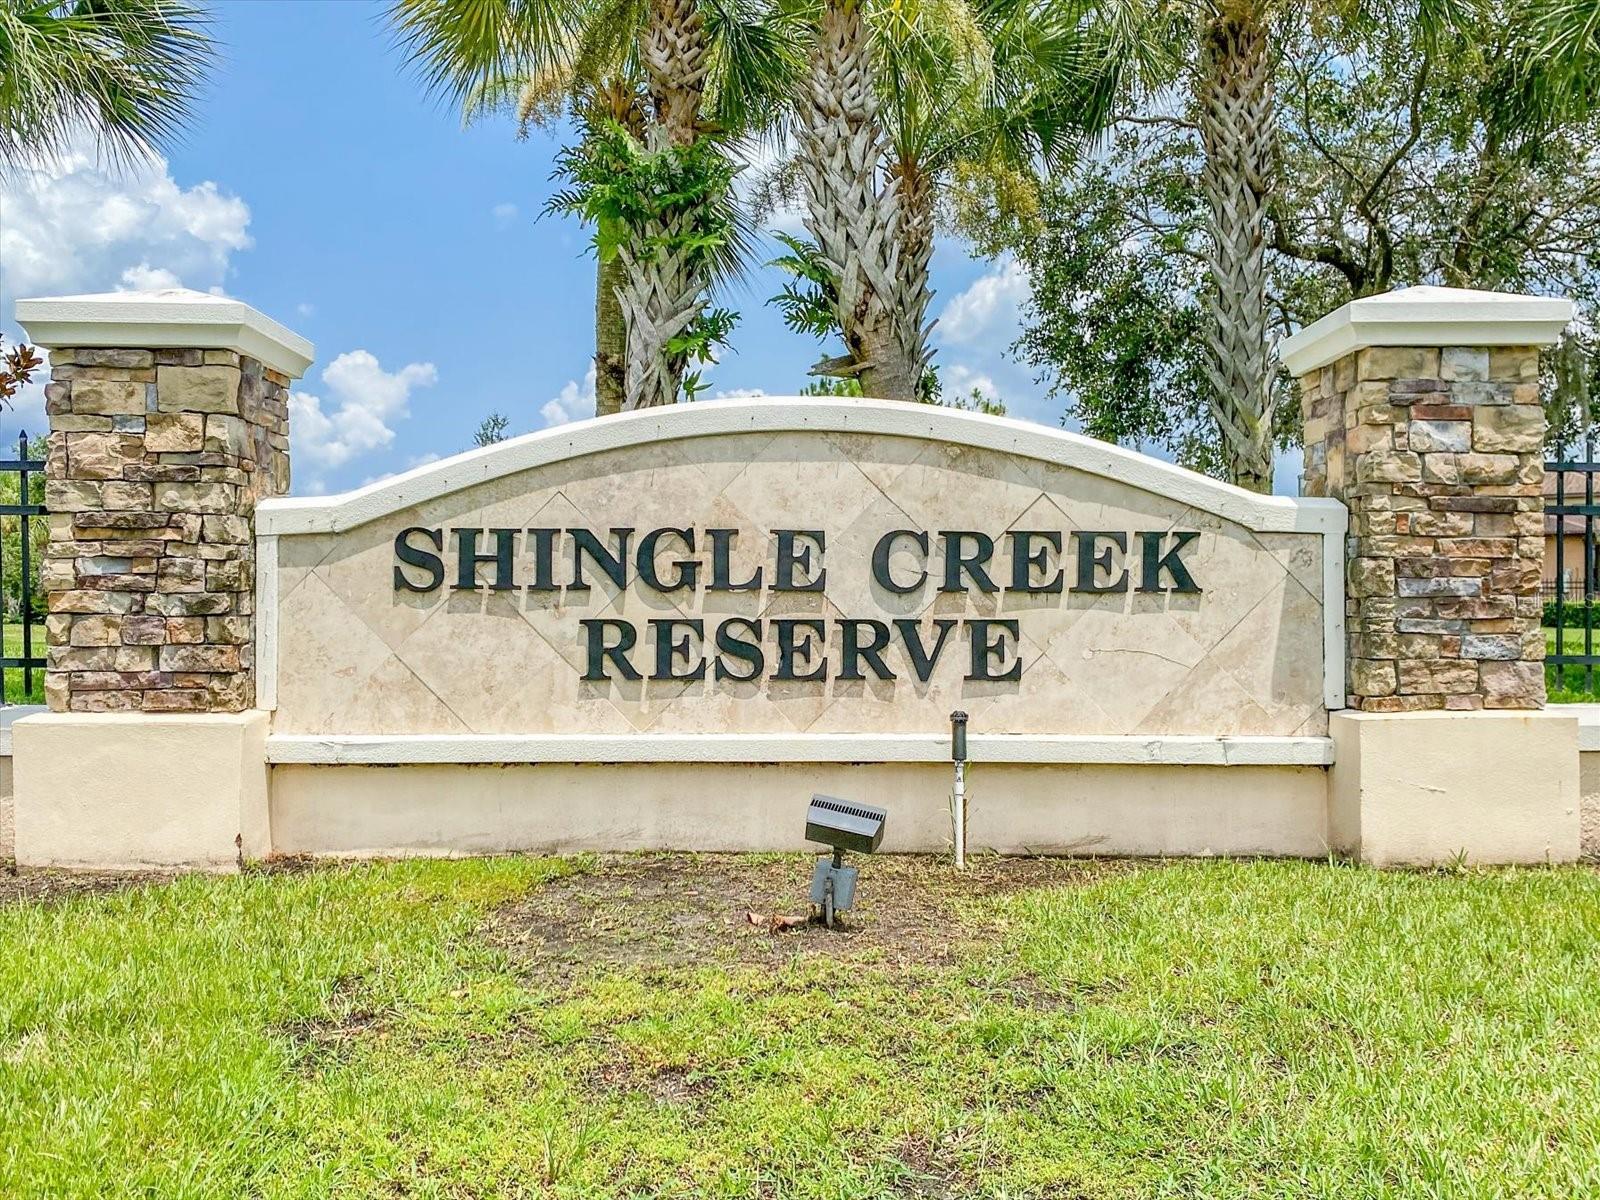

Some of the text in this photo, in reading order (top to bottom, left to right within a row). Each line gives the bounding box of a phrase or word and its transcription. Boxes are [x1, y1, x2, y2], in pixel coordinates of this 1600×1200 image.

[394, 526, 1204, 597] SHINGLE CREEK
[579, 617, 1024, 684] RESERVE
